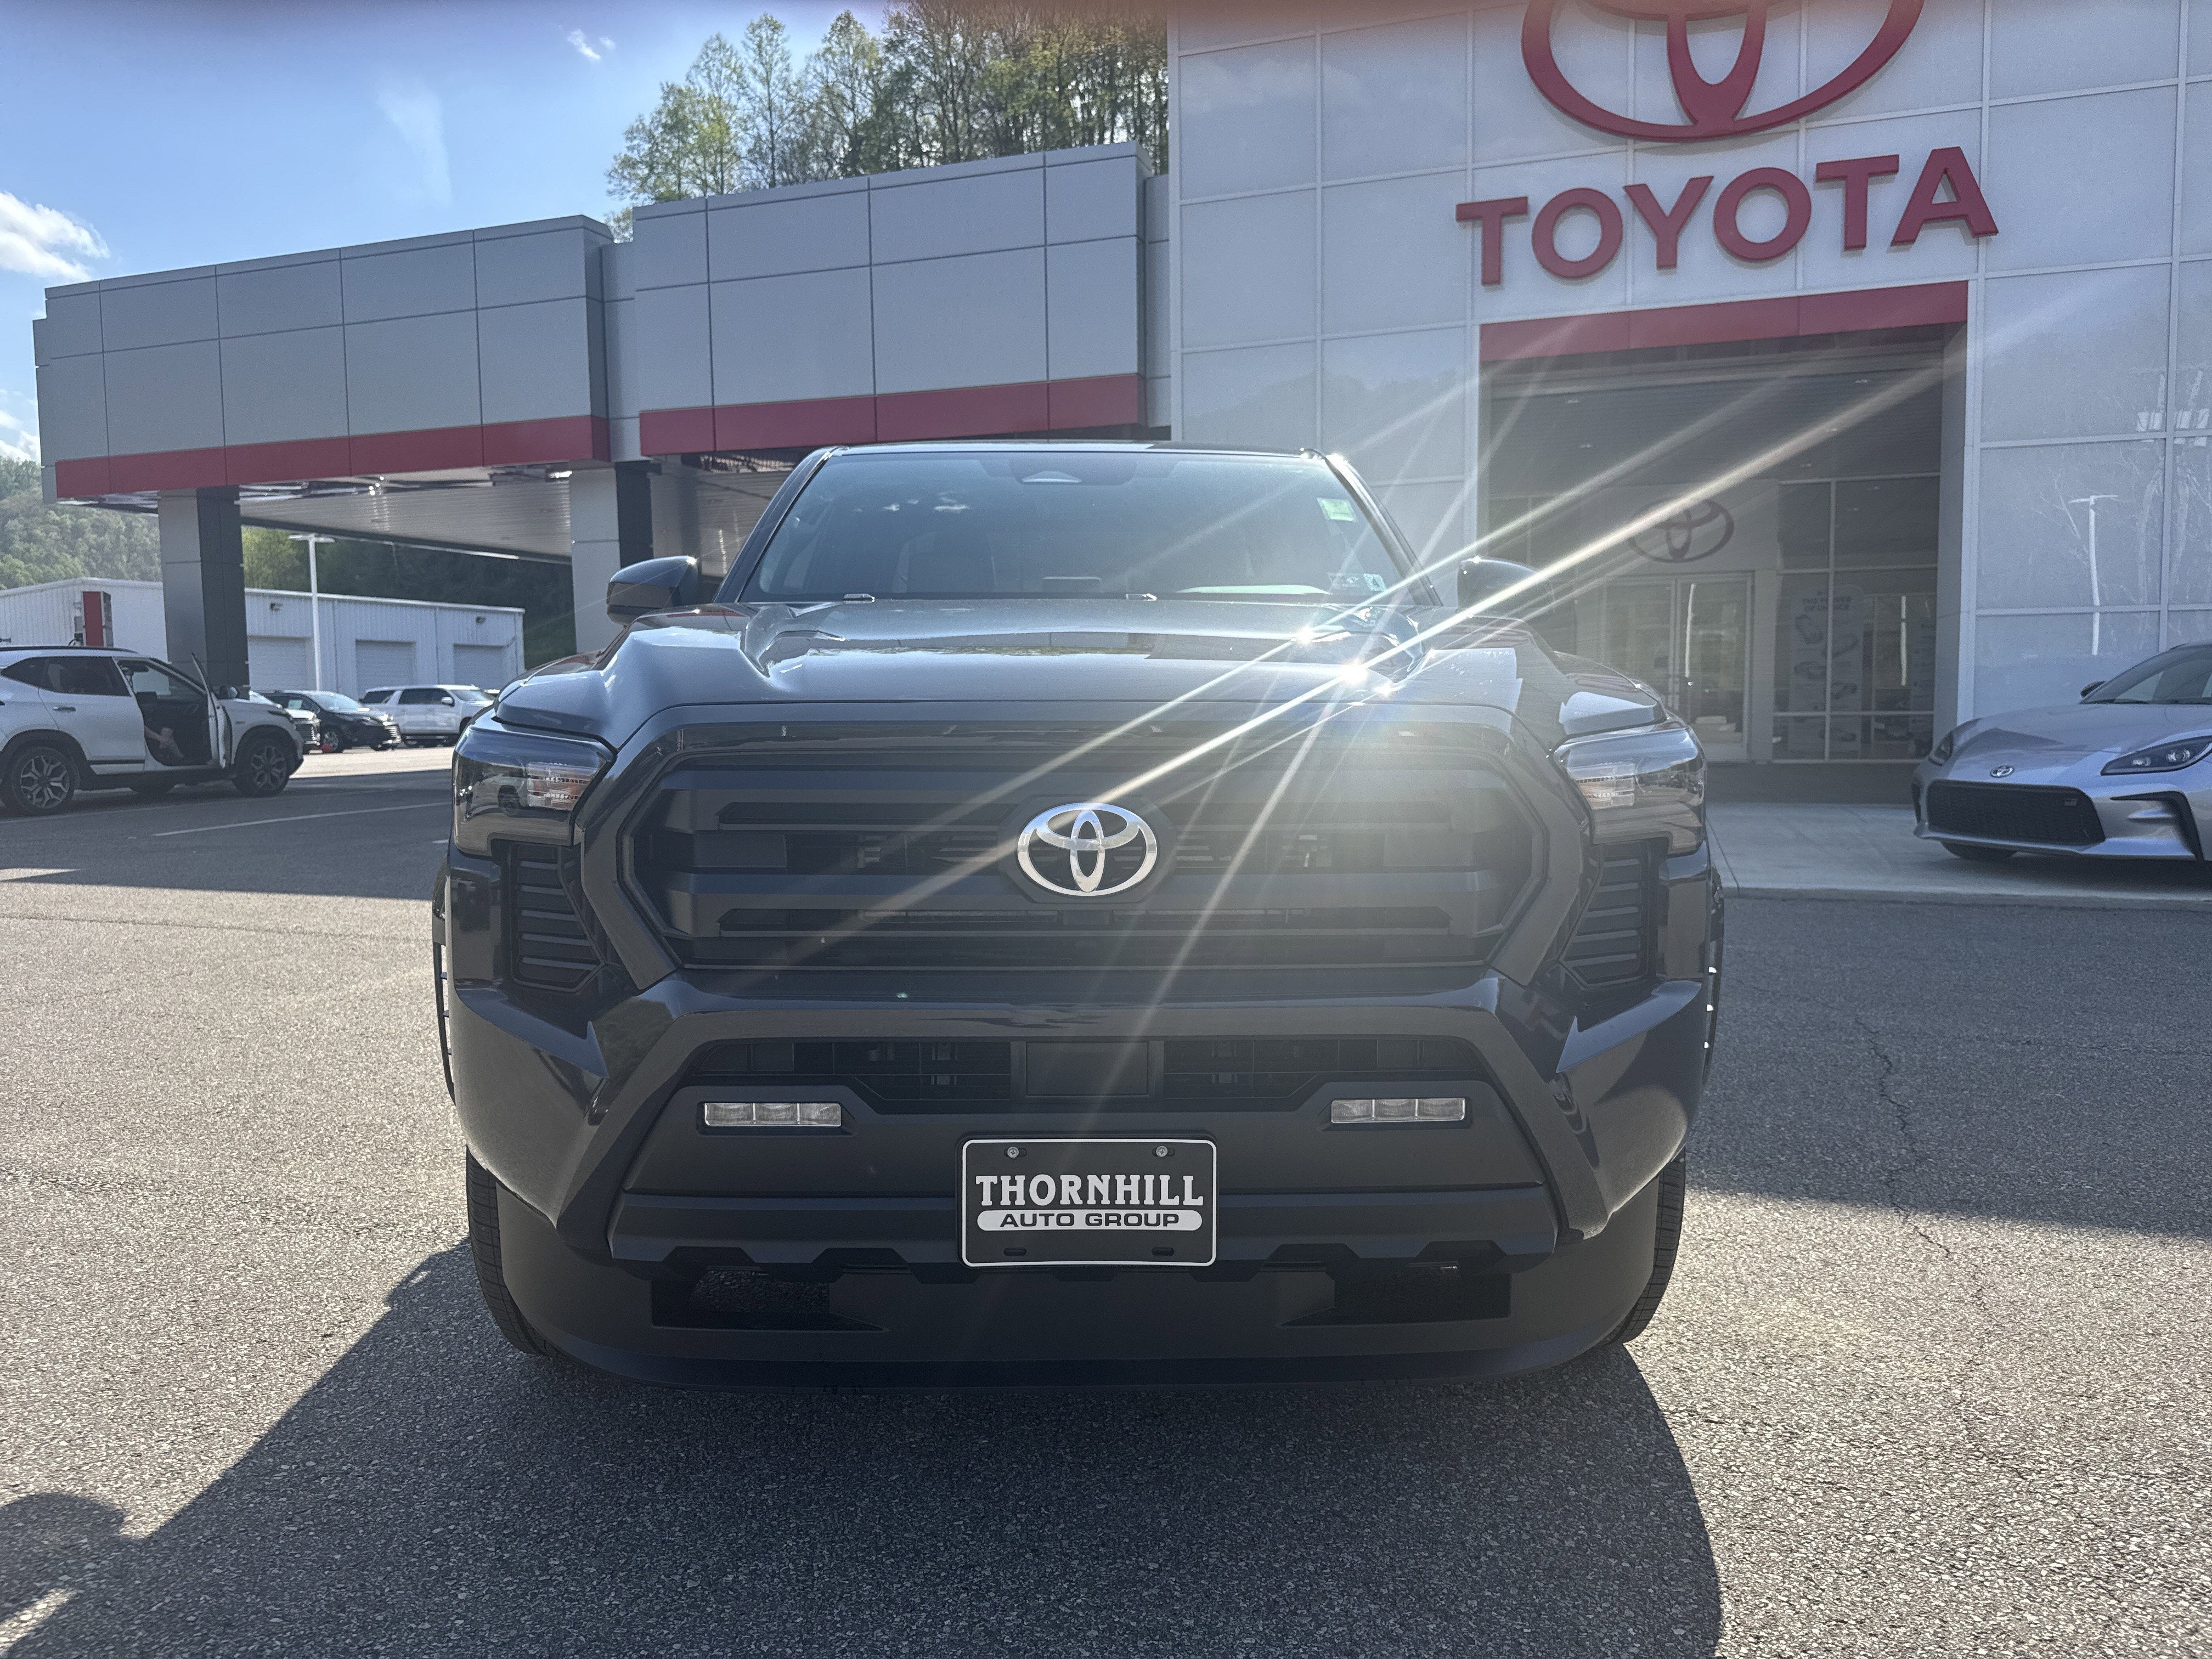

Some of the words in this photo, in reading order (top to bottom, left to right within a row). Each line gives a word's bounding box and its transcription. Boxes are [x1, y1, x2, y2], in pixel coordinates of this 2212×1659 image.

[1455, 146, 1999, 286] TOYOTA
[975, 1174, 1204, 1206] THORNHILL
[1000, 1213, 1075, 1227] AUTO
[1085, 1212, 1180, 1227] GROUP
